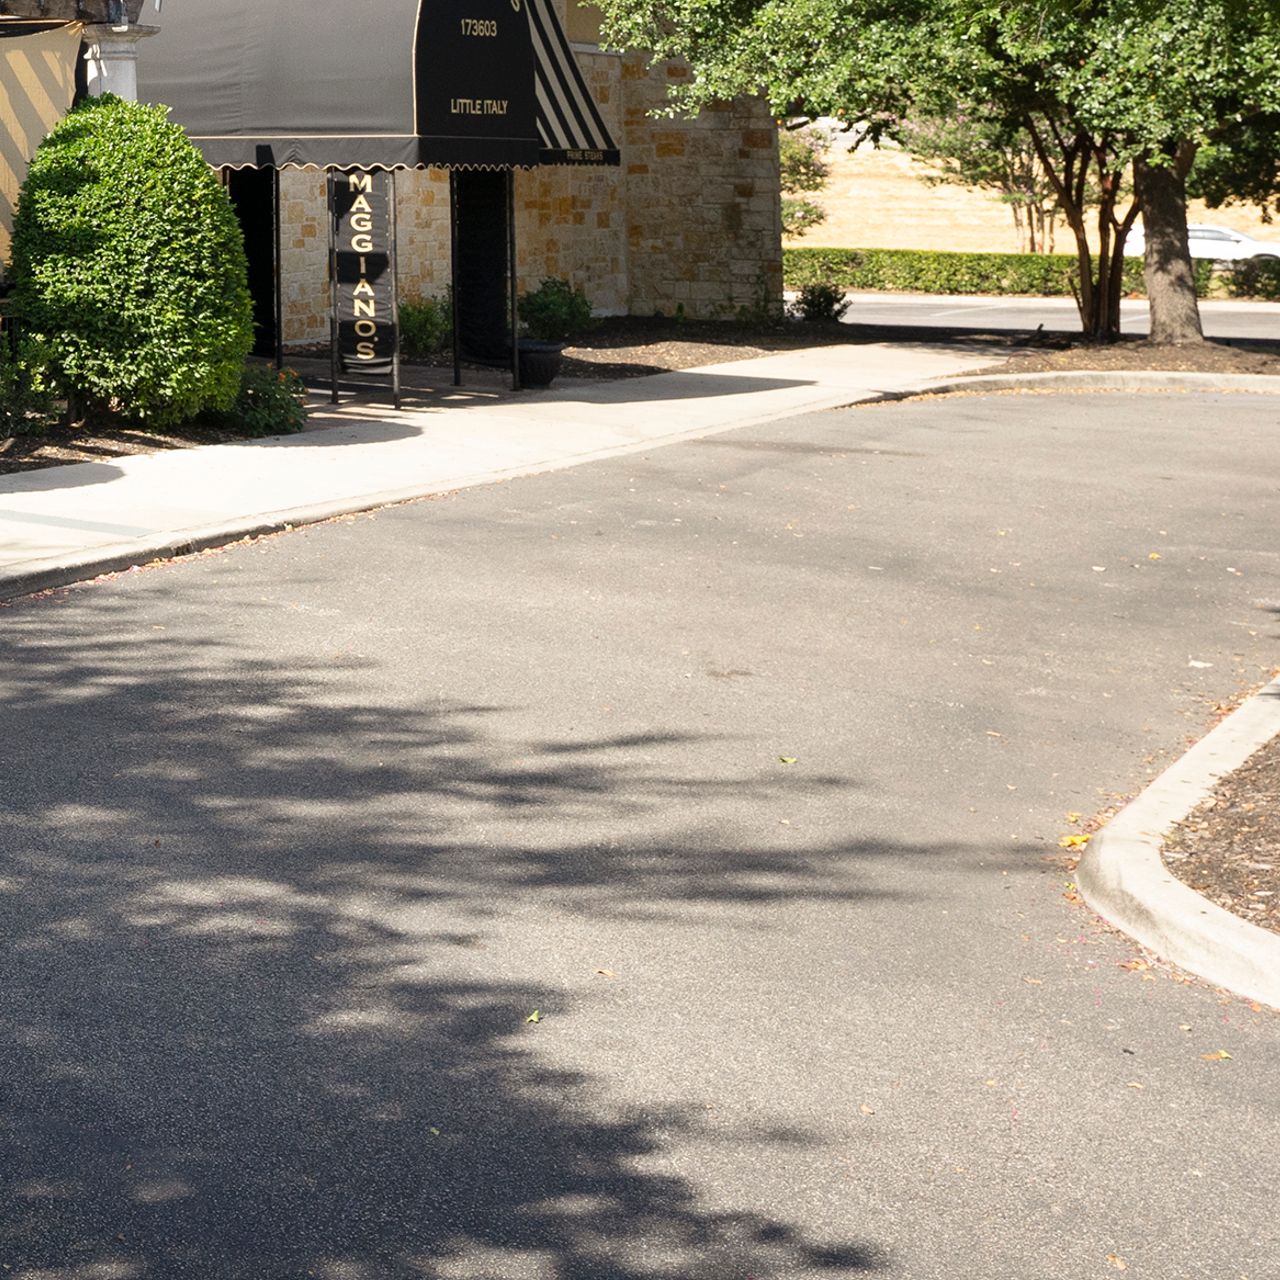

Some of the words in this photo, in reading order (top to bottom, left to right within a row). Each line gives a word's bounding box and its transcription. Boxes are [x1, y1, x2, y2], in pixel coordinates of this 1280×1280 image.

[460, 18, 498, 37] 173603
[450, 98, 482, 114] LITTLE
[483, 99, 509, 115] ITALY
[348, 173, 380, 360] MAGGIANO'S
